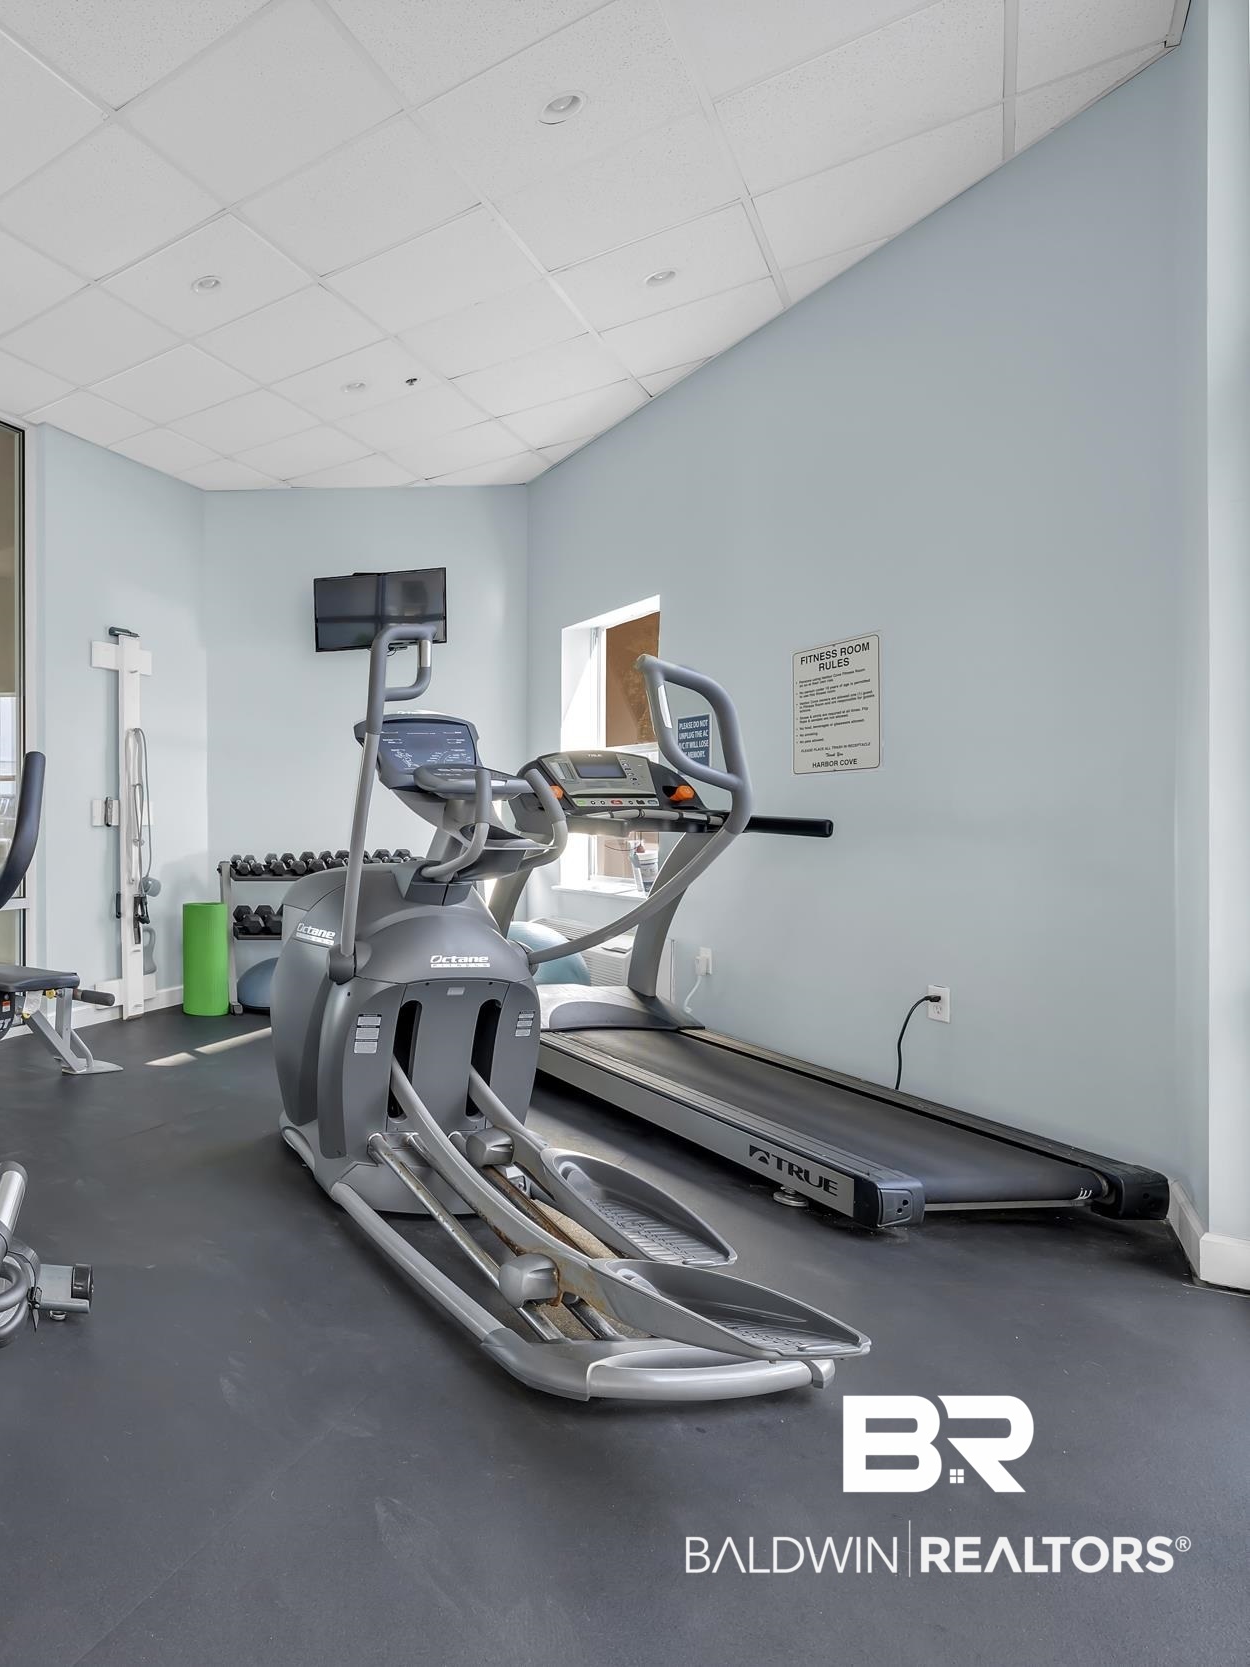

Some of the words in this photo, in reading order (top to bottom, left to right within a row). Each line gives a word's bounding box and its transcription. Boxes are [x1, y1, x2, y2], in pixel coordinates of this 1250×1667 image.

[800, 649, 838, 664] FITNESS
[840, 642, 870, 656] ROOM
[818, 657, 850, 671] RULES
[679, 722, 693, 730] PLEASE
[700, 719, 708, 727] NOT
[812, 760, 839, 768] HARBOR
[839, 758, 858, 766] COVE
[296, 922, 336, 940] Octane
[430, 955, 489, 963] Octane
[771, 1153, 839, 1197] TRUE
